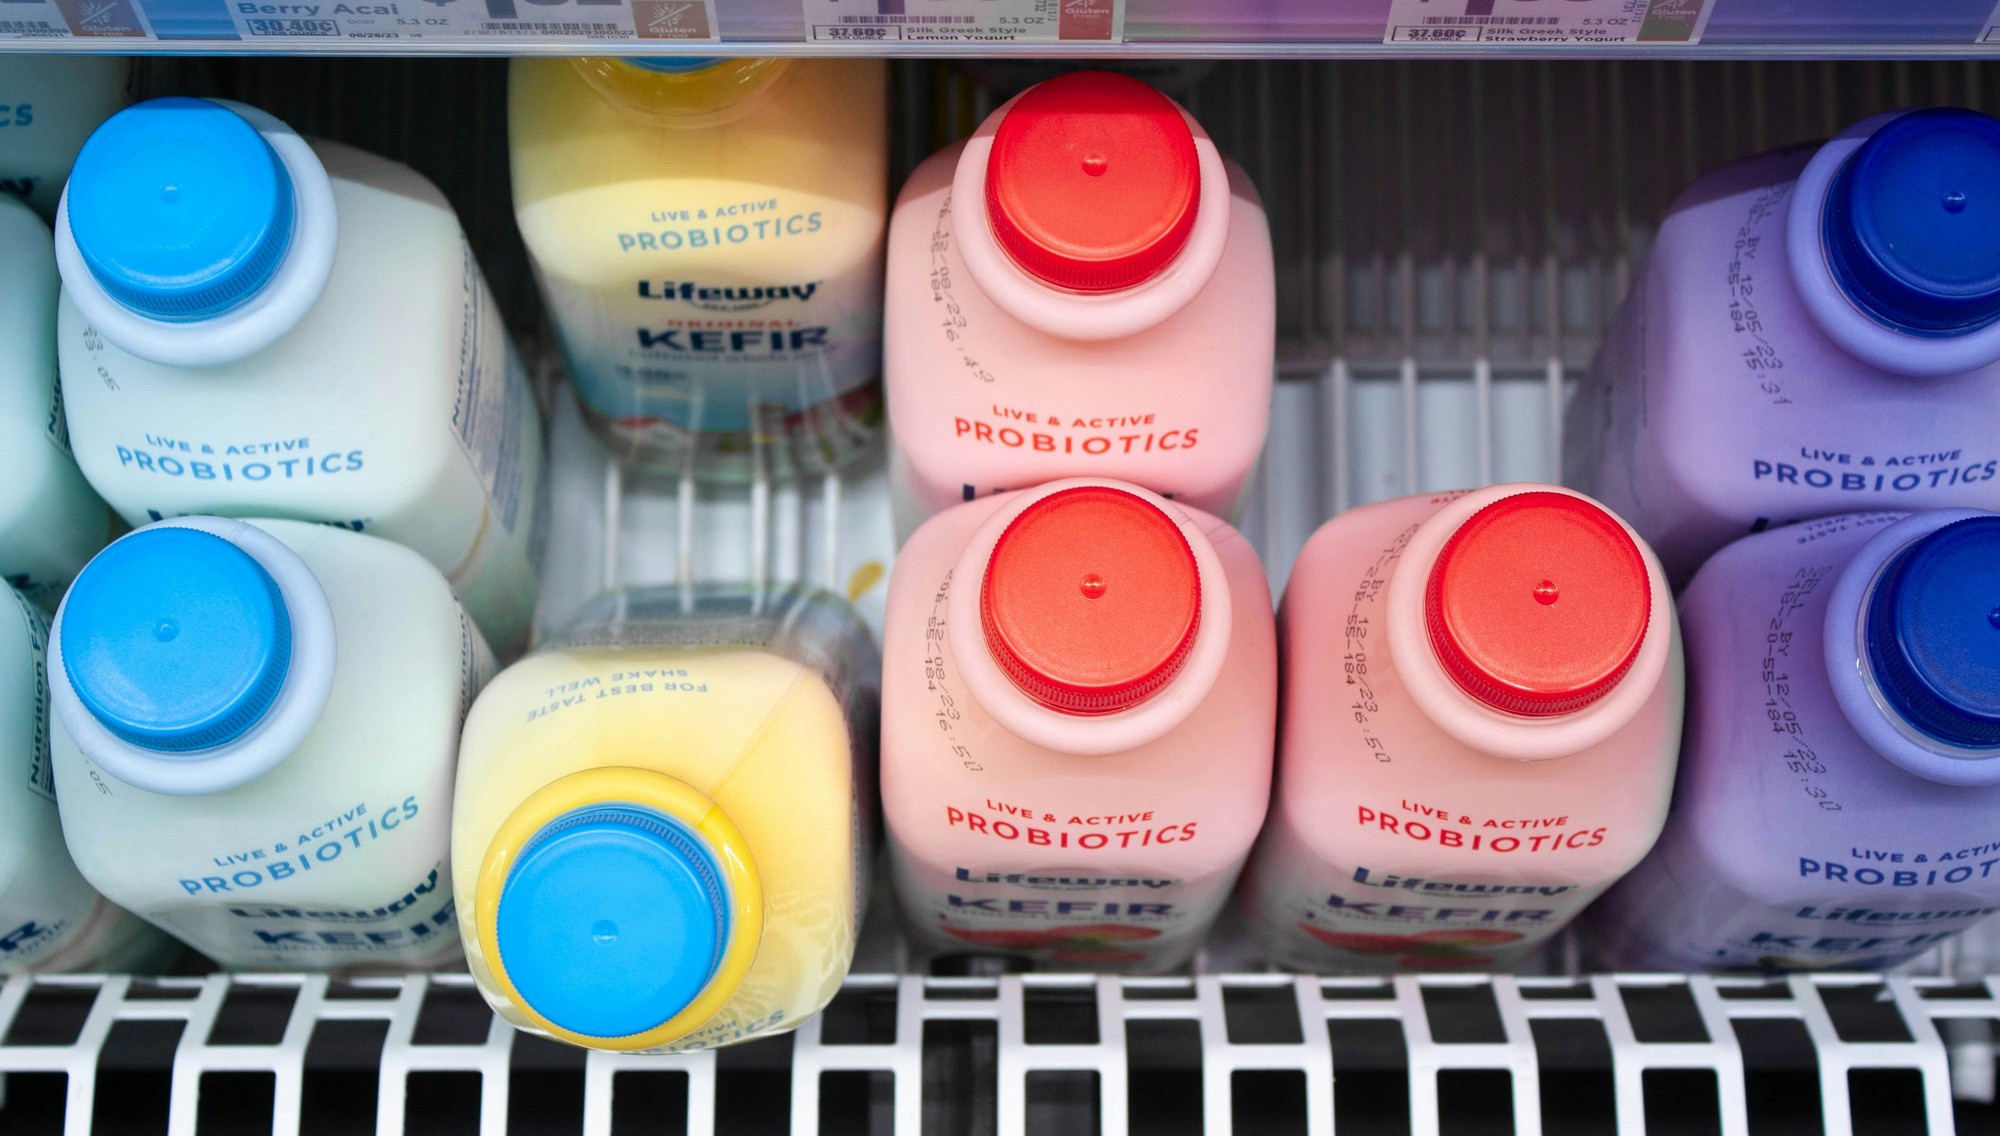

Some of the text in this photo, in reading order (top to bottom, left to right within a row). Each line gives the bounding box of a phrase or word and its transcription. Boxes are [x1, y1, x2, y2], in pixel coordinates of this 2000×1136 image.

[238, 3, 399, 16] Berry Acai
[651, 199, 778, 223] LIVE & ACTIVE
[618, 212, 823, 252] PROBIOTICS
[1745, 236, 1761, 259] BY
[638, 280, 817, 302] Lifeway
[940, 231, 967, 328] 12/08/23
[1740, 274, 1784, 369] 12/05/23
[637, 326, 829, 352] KEFIR
[993, 405, 1156, 428] LIVE & ACTIVE
[146, 434, 310, 455] LIVE & ACTIVE
[955, 416, 1199, 455] PROBIOTICS
[116, 445, 364, 481] PROBIOTICS
[1801, 447, 1962, 467] LIVE & ACTIVE
[1754, 460, 1998, 492] PROBIOTICS
[1366, 579, 1385, 602] BY
[1777, 631, 1793, 657] BY
[934, 619, 960, 720] 12/08/23
[1355, 617, 1379, 713] 12/08/23
[546, 669, 688, 697] SHAKE WELL
[527, 682, 708, 722] FOR BEST TASTE
[30, 661, 43, 785] Nutrition
[1352, 702, 1391, 763] 16:50
[1776, 672, 1827, 774] 12/05/23
[936, 710, 983, 771] 16:50
[947, 806, 1198, 849] PROBIOTICS
[986, 799, 1154, 826] LIVE & ACTIVE
[1402, 799, 1569, 830] LIVE & ACTIVE
[213, 803, 367, 867] LIVE & ACTIVE
[1358, 805, 1607, 853] PROBIOTICS
[178, 796, 419, 896] PROBIOTICS
[1852, 842, 2000, 864] LIVE & ACTIV
[1352, 866, 1570, 897] Lifeway
[1799, 857, 2000, 887] PROBIOT
[948, 894, 1175, 917] KEFIR
[1326, 893, 1554, 921] KEFIR
